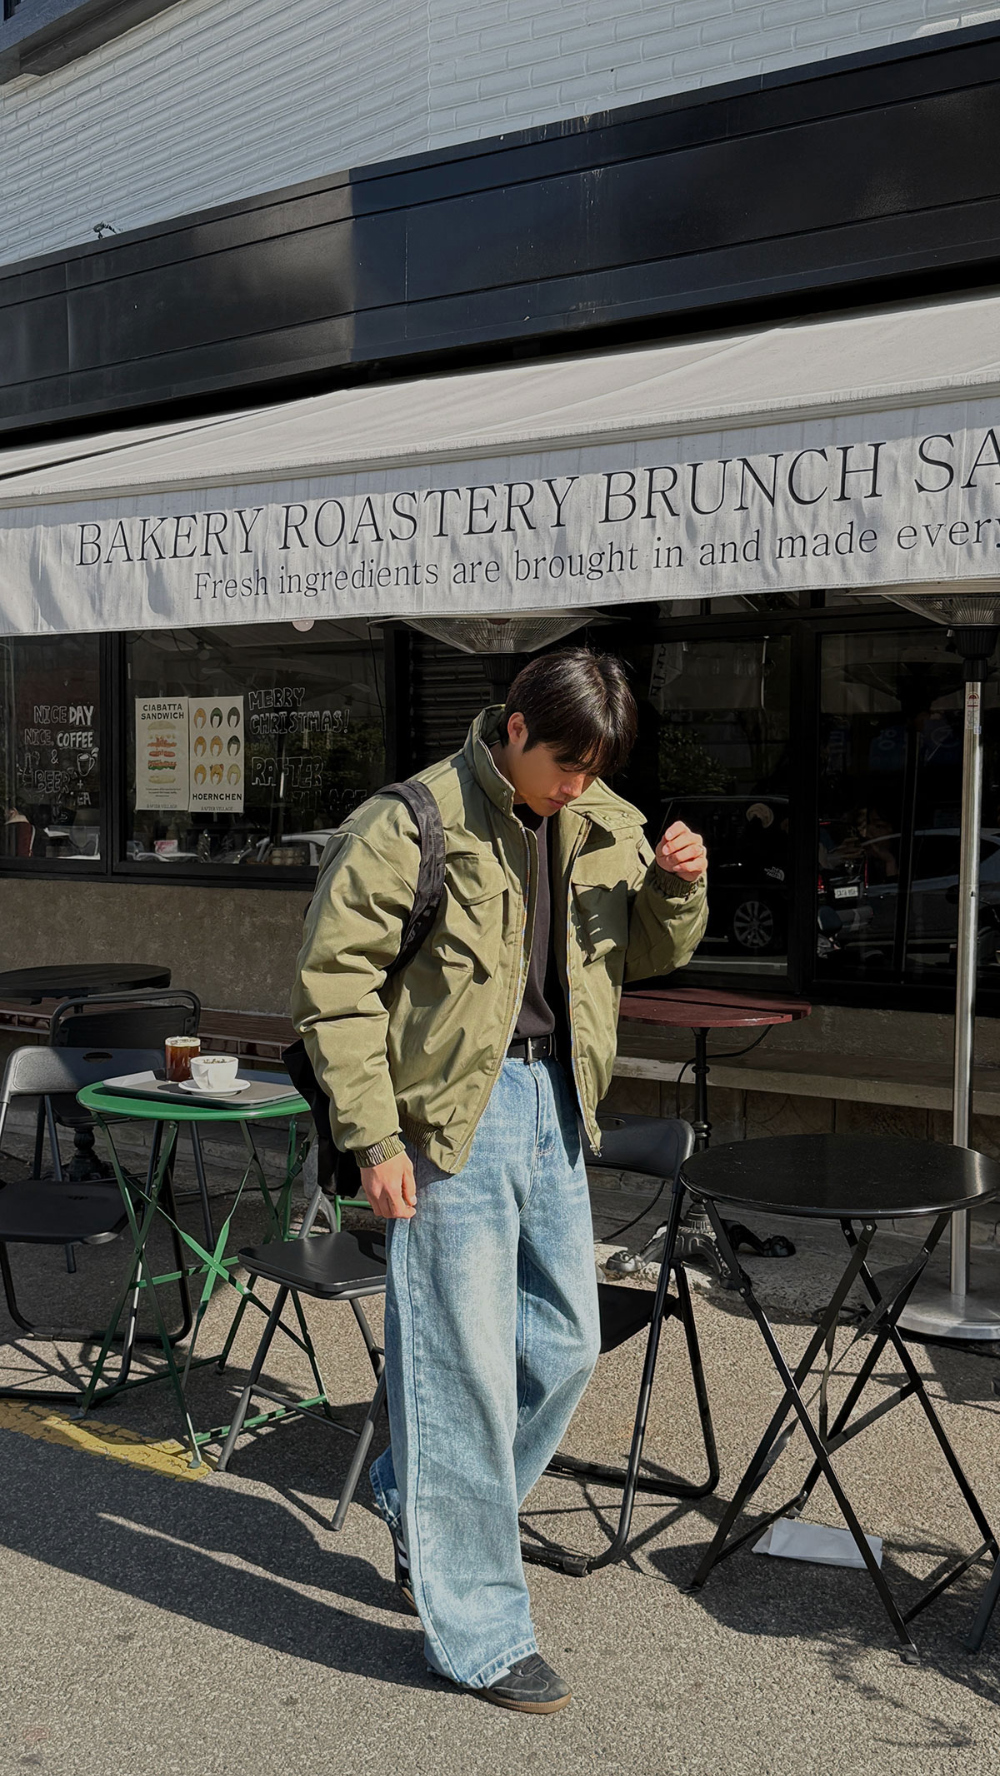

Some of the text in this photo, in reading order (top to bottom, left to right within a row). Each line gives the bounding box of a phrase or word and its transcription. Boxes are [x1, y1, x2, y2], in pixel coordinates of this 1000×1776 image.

[75, 428, 1000, 567] BAKERY ROASTERY BRUNCH SA
[194, 570, 269, 600] Fresh
[279, 558, 440, 599] ingredients
[452, 555, 501, 584] are
[514, 541, 639, 582] brought
[653, 536, 684, 569] in
[699, 529, 761, 566] and
[775, 520, 878, 559] made
[142, 703, 183, 712] CIABATTA
[248, 686, 306, 711] MERRY
[33, 704, 95, 727] NICE DAY
[140, 711, 185, 721] SANDWICH
[248, 708, 351, 734] CHRISTMAS!
[56, 730, 94, 749] COFFEE
[33, 769, 71, 794] BEER
[192, 792, 243, 801] HOERNCHEN
